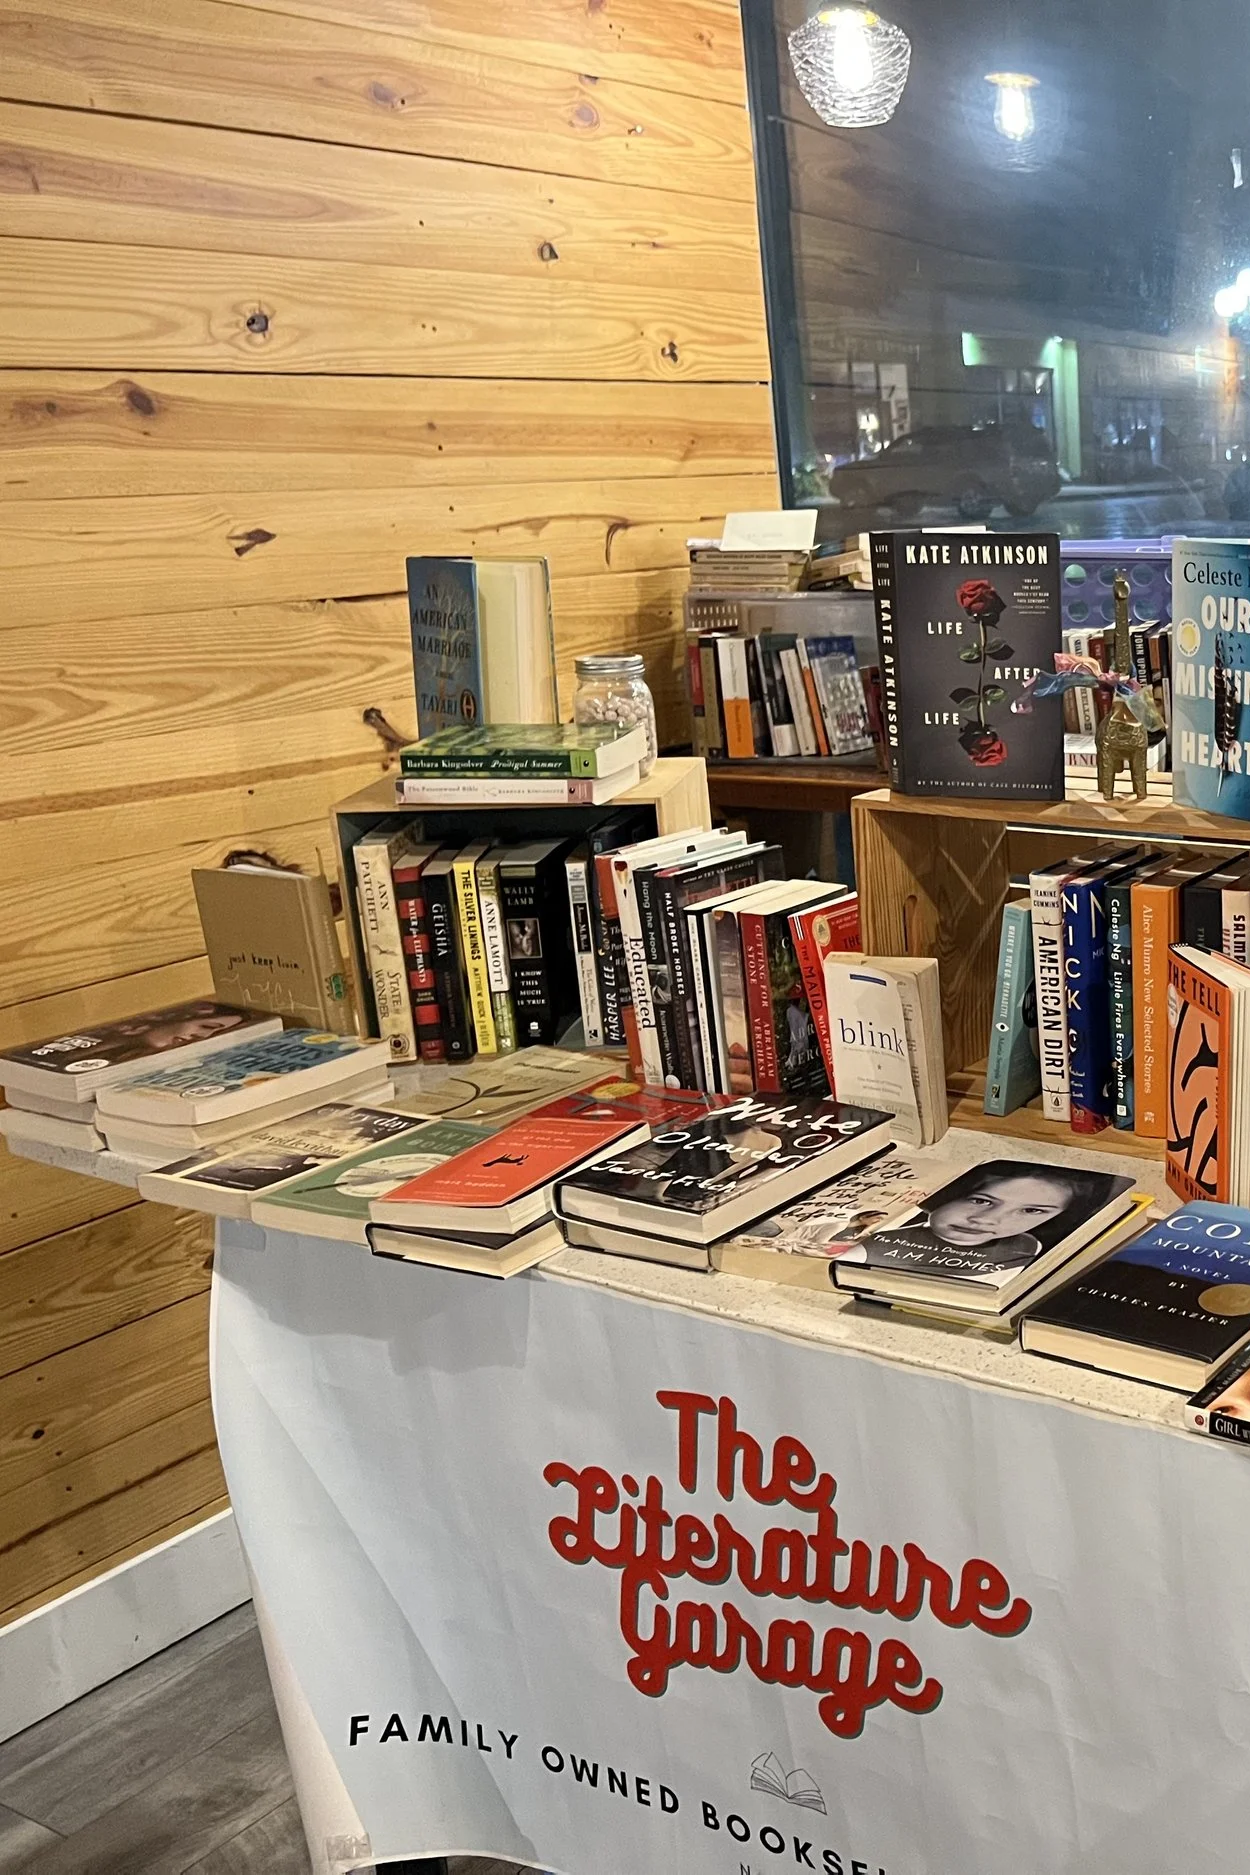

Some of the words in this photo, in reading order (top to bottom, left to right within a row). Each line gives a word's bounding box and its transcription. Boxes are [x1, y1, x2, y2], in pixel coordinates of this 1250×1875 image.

[905, 545, 950, 564] KATE
[960, 545, 1049, 565] ATKINSON
[1183, 561, 1243, 587] Celeste
[412, 610, 468, 630] AMERICAN
[880, 599, 893, 644] KATE
[927, 621, 963, 635] LIFE
[1134, 634, 1145, 656] JOHN
[884, 654, 899, 747] ATKINSON
[924, 712, 960, 725] LIFE
[407, 759, 439, 768] Barbara
[442, 759, 484, 770] Kingsolver
[360, 861, 380, 933] PATCHETT
[377, 880, 390, 911] ANN
[461, 870, 472, 890] THE
[504, 887, 536, 895] WALLY
[641, 881, 650, 909] Hang
[1034, 890, 1058, 898] JEANINE
[464, 892, 478, 922] SILVER
[484, 900, 498, 932] ANNE
[507, 897, 535, 905] LAMB
[664, 892, 675, 918] HALF
[1033, 900, 1060, 909] CUMMINS
[1143, 904, 1153, 929] Alice
[431, 903, 448, 957] GEISHA
[645, 911, 654, 929] the
[1111, 898, 1120, 941] Celeste
[467, 924, 482, 961] LININGS
[649, 931, 658, 960] Moon
[668, 922, 680, 954] BROKE
[1111, 944, 1120, 960] Ng
[1143, 932, 1154, 975] Munro
[228, 953, 246, 970] just
[489, 934, 503, 985] LAMOTT
[603, 965, 615, 987] LEE
[674, 958, 686, 996] HORSES
[747, 945, 757, 985] STONE
[754, 924, 766, 983] CUTTING
[760, 984, 769, 1008] FOR
[374, 969, 388, 1019] WONDER
[387, 971, 402, 1007] STATE
[628, 937, 656, 1029] Educated
[803, 965, 823, 1011] MAID
[817, 1015, 826, 1036] NITA
[1038, 935, 1062, 1032] AMERICAN
[1113, 972, 1122, 999] Little
[1143, 978, 1154, 1002] New
[1168, 959, 1187, 994] THE
[1192, 974, 1221, 1016] TELL
[604, 992, 619, 1041] HARPER
[1115, 1003, 1124, 1029] Fires
[1143, 1005, 1154, 1052] Selected
[754, 1017, 766, 1078] VERGHESE
[763, 1022, 775, 1077] ABRAHAM
[838, 1018, 905, 1057] blink
[1043, 1038, 1065, 1080] DIRT
[1116, 1032, 1126, 1099] Everywhere
[1143, 1055, 1154, 1094] Stories
[708, 1096, 863, 1136] White
[652, 1131, 812, 1167] Oleander
[590, 1156, 674, 1178] Janet
[671, 1174, 738, 1194] Fitch
[873, 1233, 891, 1245] The
[893, 1238, 940, 1255] Mistress's
[940, 1246, 989, 1261] Daughter
[883, 1249, 927, 1265] A.M.
[930, 1256, 1006, 1274] HOMES
[1162, 1259, 1173, 1268] A
[1180, 1264, 1232, 1281] NOVEL
[1167, 1280, 1189, 1290] BY
[1076, 1286, 1150, 1309] CHARLES
[1156, 1304, 1230, 1326] FRAZIER
[1215, 1417, 1241, 1438] GIRL
[655, 1389, 838, 1513] The
[541, 1460, 1033, 1639] Literature
[619, 1563, 945, 1741] Garage
[348, 1713, 520, 1760] FAMILY
[540, 1744, 681, 1815] OWNED
[701, 1800, 886, 1875] BOOKSE
